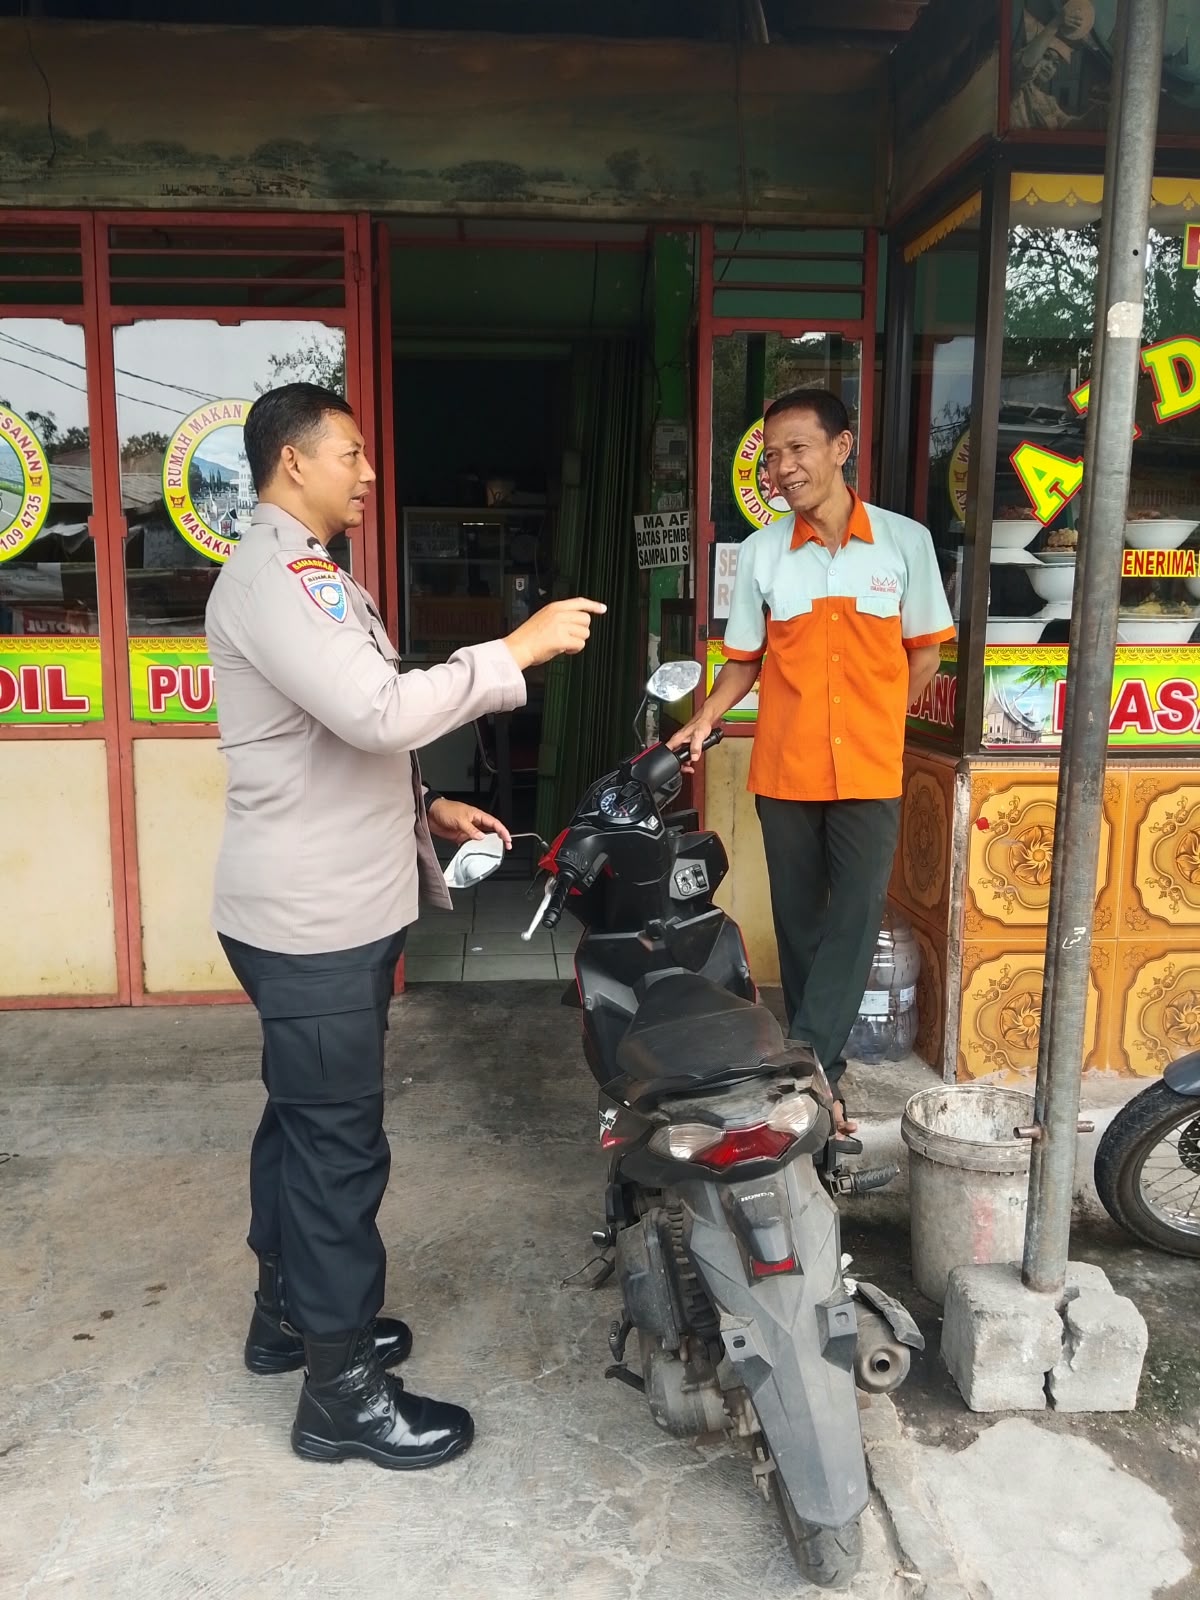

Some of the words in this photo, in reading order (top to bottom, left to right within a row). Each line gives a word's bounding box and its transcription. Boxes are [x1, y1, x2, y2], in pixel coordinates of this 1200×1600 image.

[167, 432, 193, 488] RUMAH
[188, 403, 243, 435] MAKAN
[1009, 334, 1200, 527] AD
[21, 495, 42, 529] 4735
[643, 516, 665, 529] MA
[669, 512, 689, 527] AF
[636, 530, 661, 547] BATAS
[638, 547, 668, 567] SAMPAI
[670, 546, 680, 563] DI
[1122, 549, 1196, 577] ENERIMA
[148, 665, 218, 715] PU
[1053, 678, 1200, 735] AS
[740, 1191, 775, 1203] HONDA
